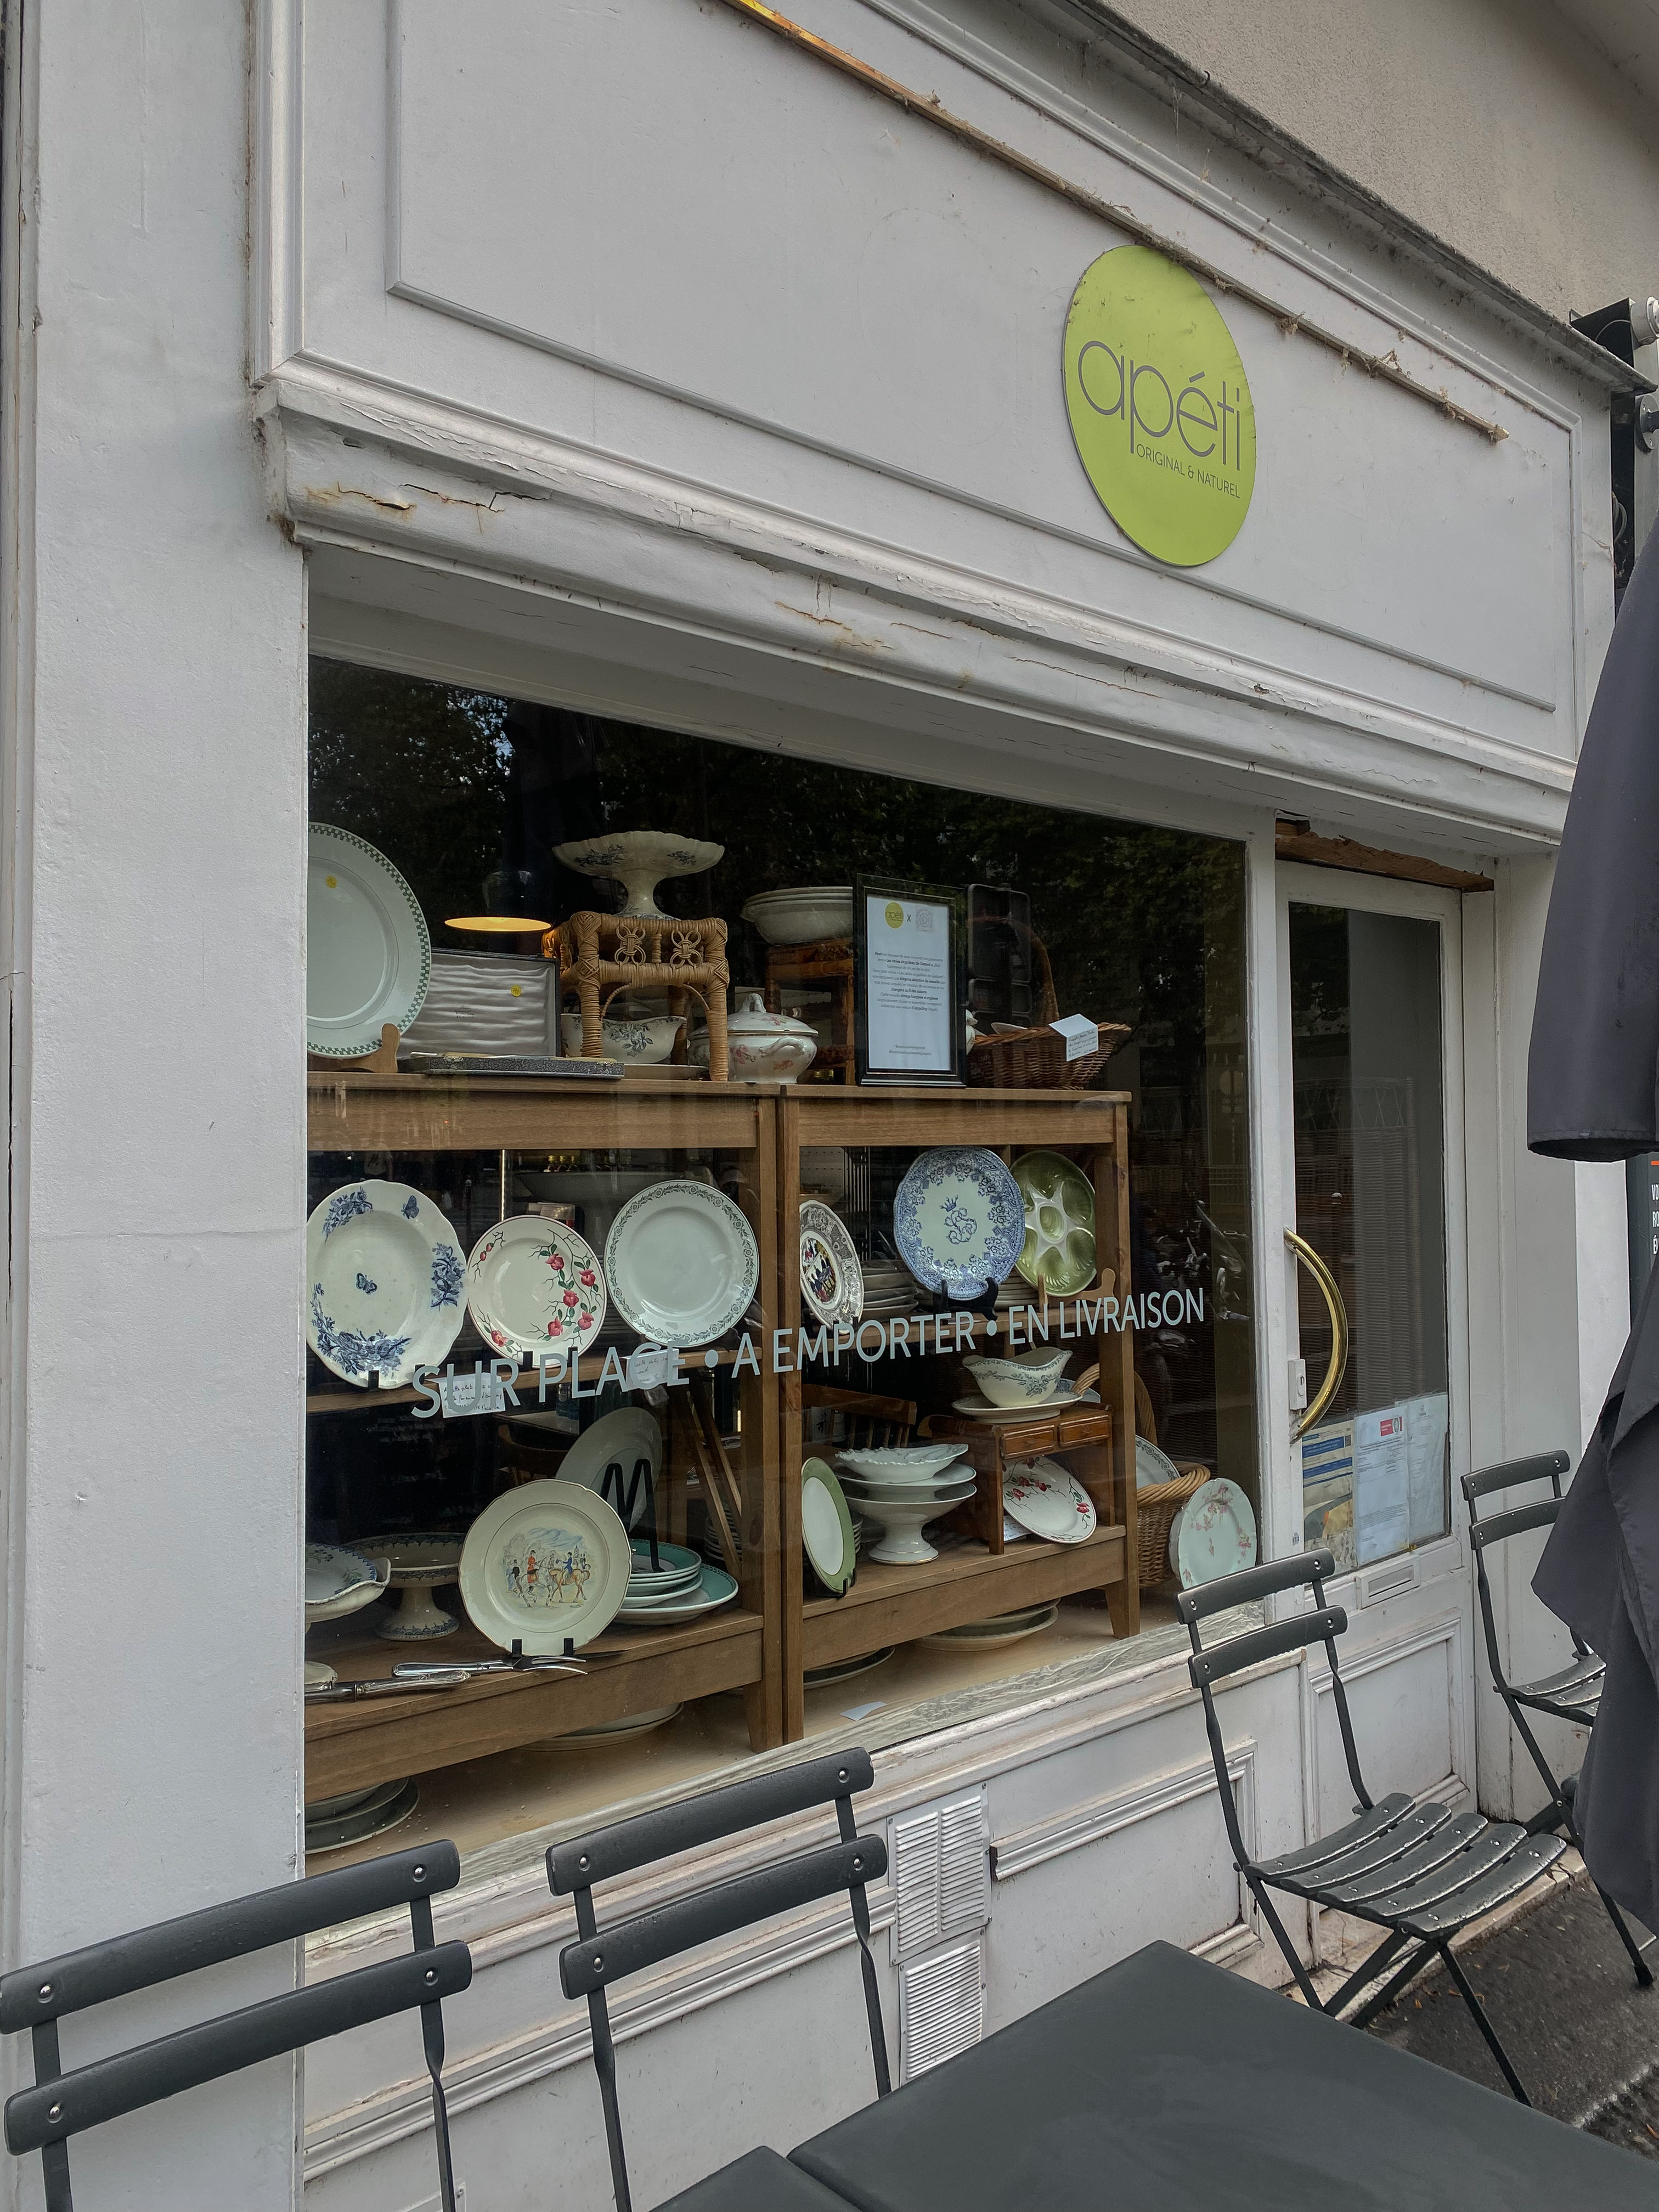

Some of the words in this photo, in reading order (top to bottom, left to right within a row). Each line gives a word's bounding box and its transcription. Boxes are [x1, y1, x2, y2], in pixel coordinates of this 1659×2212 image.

[1077, 340, 1240, 471] apéti
[1136, 443, 1186, 476] ORIGINAL
[1188, 465, 1194, 479] &
[1197, 469, 1240, 499] NATUREL
[411, 1358, 521, 1419] SUR
[538, 1339, 690, 1402] PLACE
[731, 1332, 761, 1378] A
[772, 1311, 977, 1374] EMPORTER
[1008, 1302, 1049, 1346] EN
[1059, 1288, 1204, 1339] LIVRAISON
